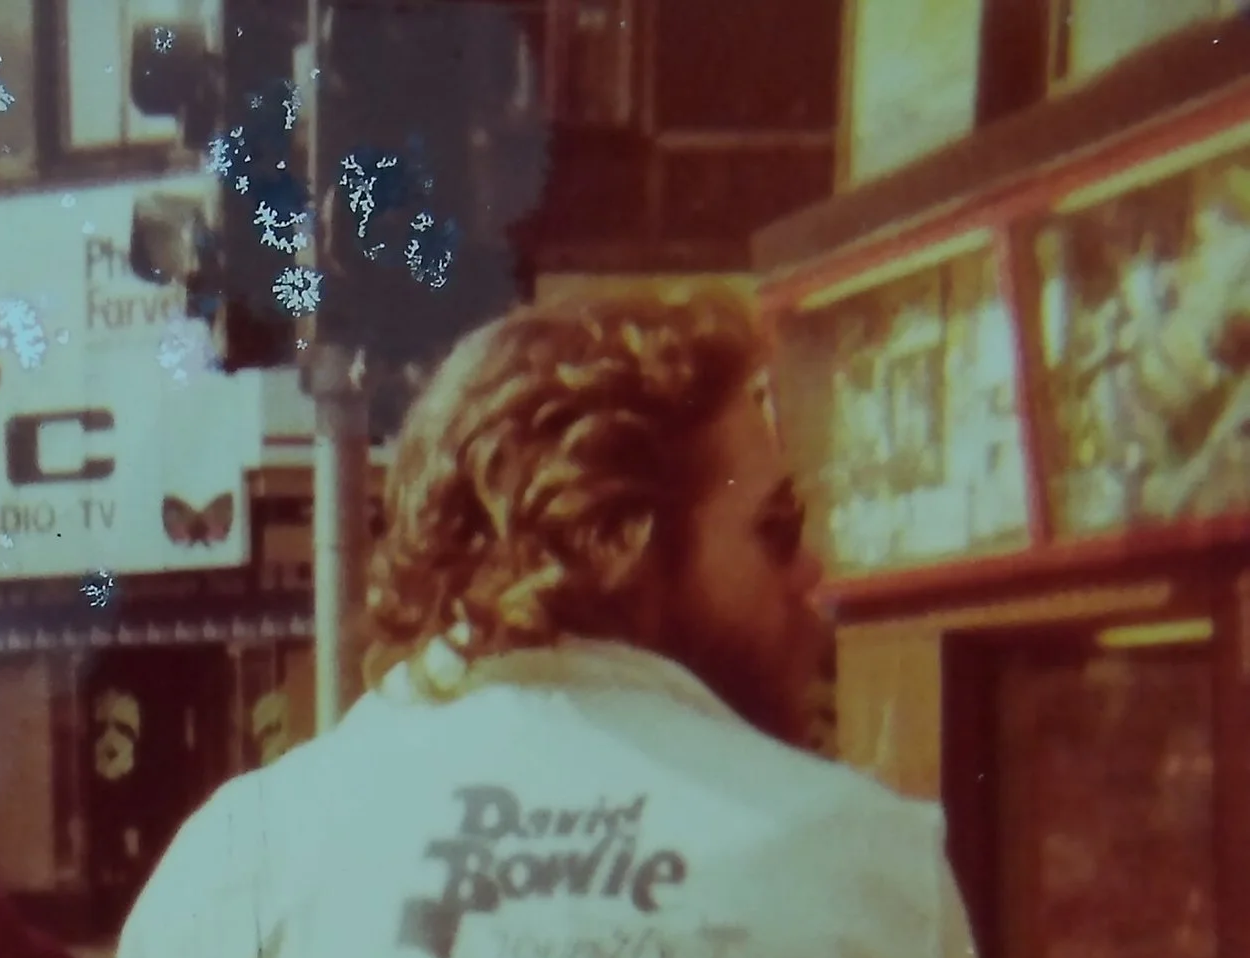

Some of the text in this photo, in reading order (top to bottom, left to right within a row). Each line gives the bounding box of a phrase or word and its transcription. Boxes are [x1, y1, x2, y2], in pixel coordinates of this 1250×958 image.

[82, 499, 116, 530] TV
[452, 784, 647, 840] David
[423, 836, 687, 914] Bowie
